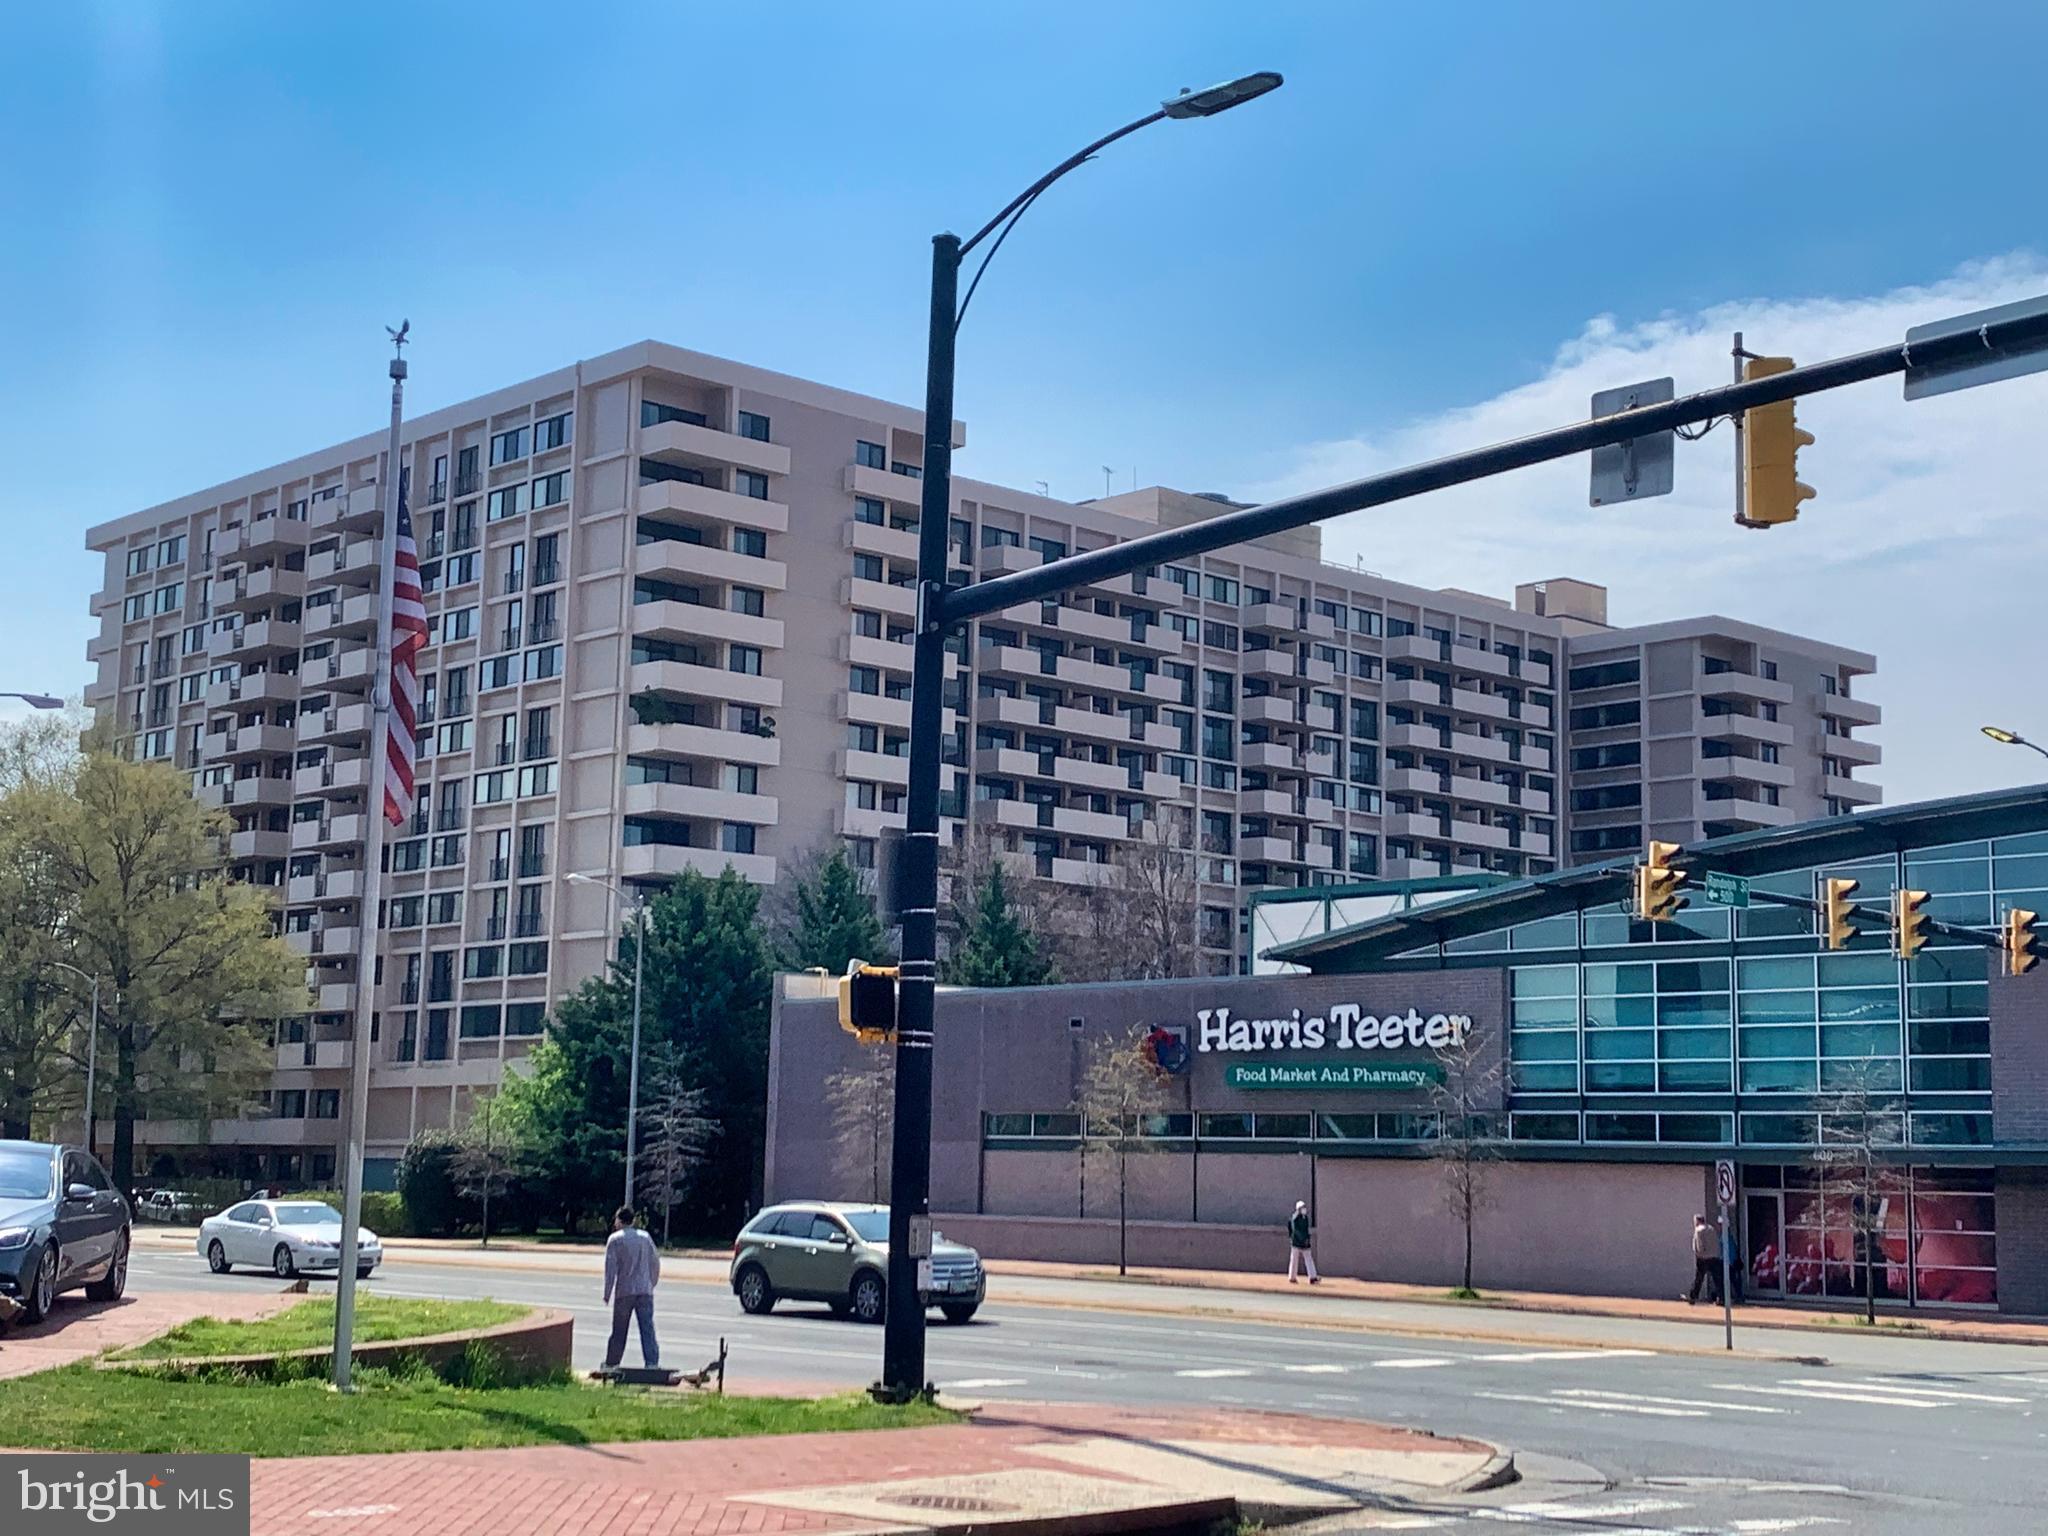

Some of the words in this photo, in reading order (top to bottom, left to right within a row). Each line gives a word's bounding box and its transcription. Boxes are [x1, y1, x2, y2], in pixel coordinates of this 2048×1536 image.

[1197, 1007, 1325, 1052] Harris
[1330, 1003, 1471, 1049] Teeter
[1236, 1067, 1267, 1082] Food
[1270, 1067, 1317, 1082] Market
[1320, 1067, 1349, 1082] And
[1353, 1067, 1426, 1086] Pharmacy
